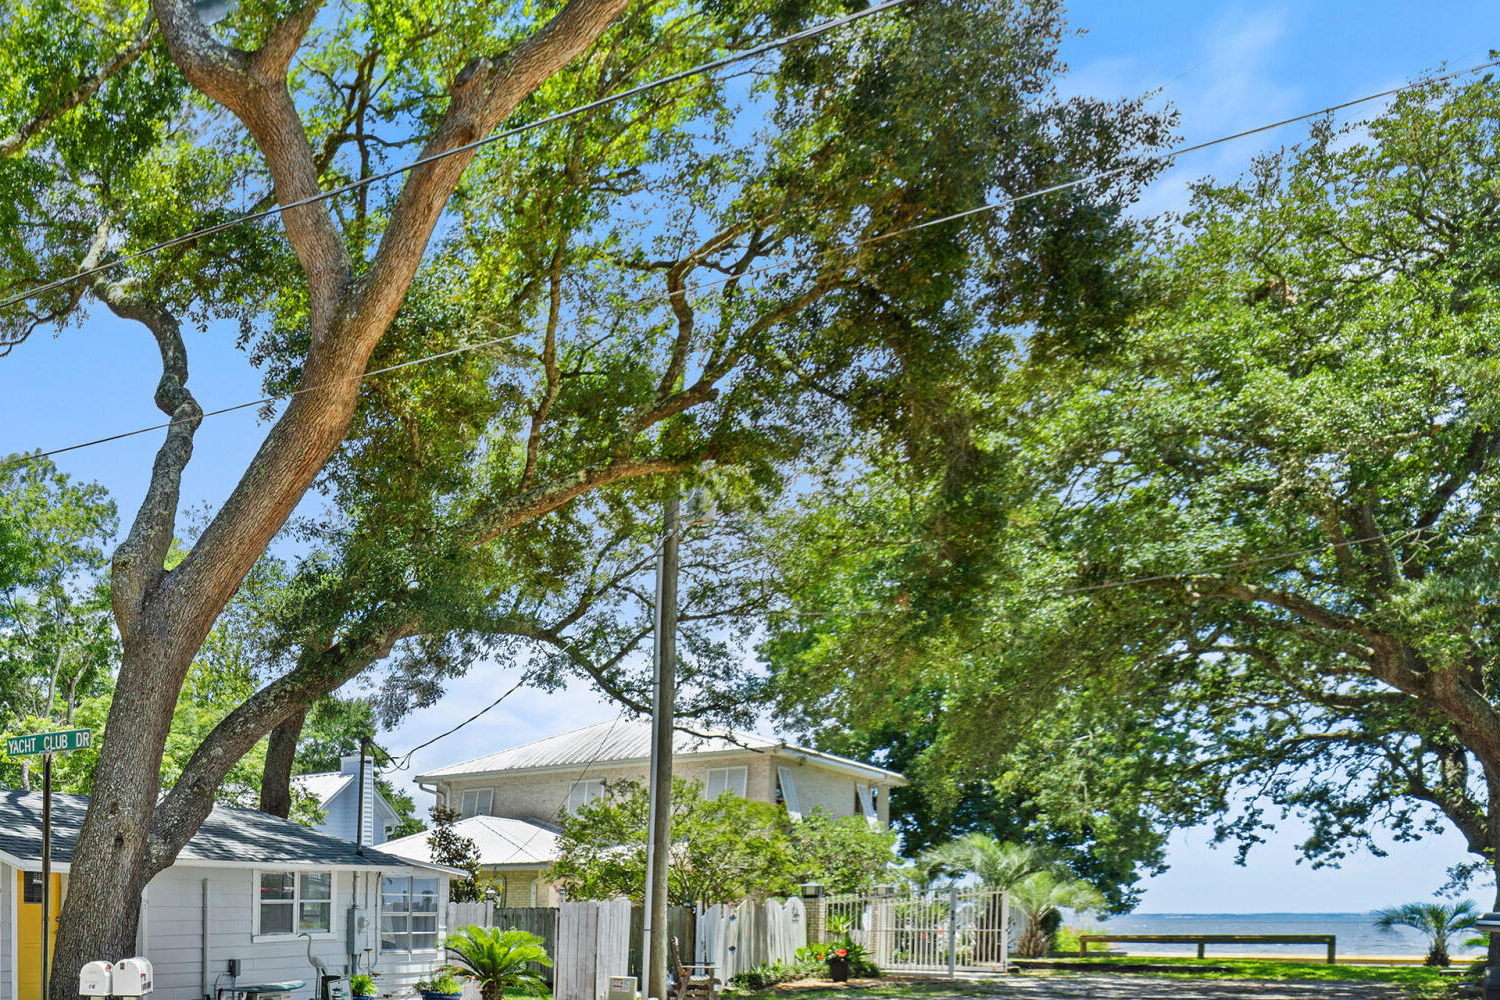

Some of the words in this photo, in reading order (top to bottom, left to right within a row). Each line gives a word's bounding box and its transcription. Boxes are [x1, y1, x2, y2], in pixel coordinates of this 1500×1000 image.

[8, 737, 36, 754] YACHT
[43, 734, 68, 750] CLUB
[75, 731, 90, 747] DR
